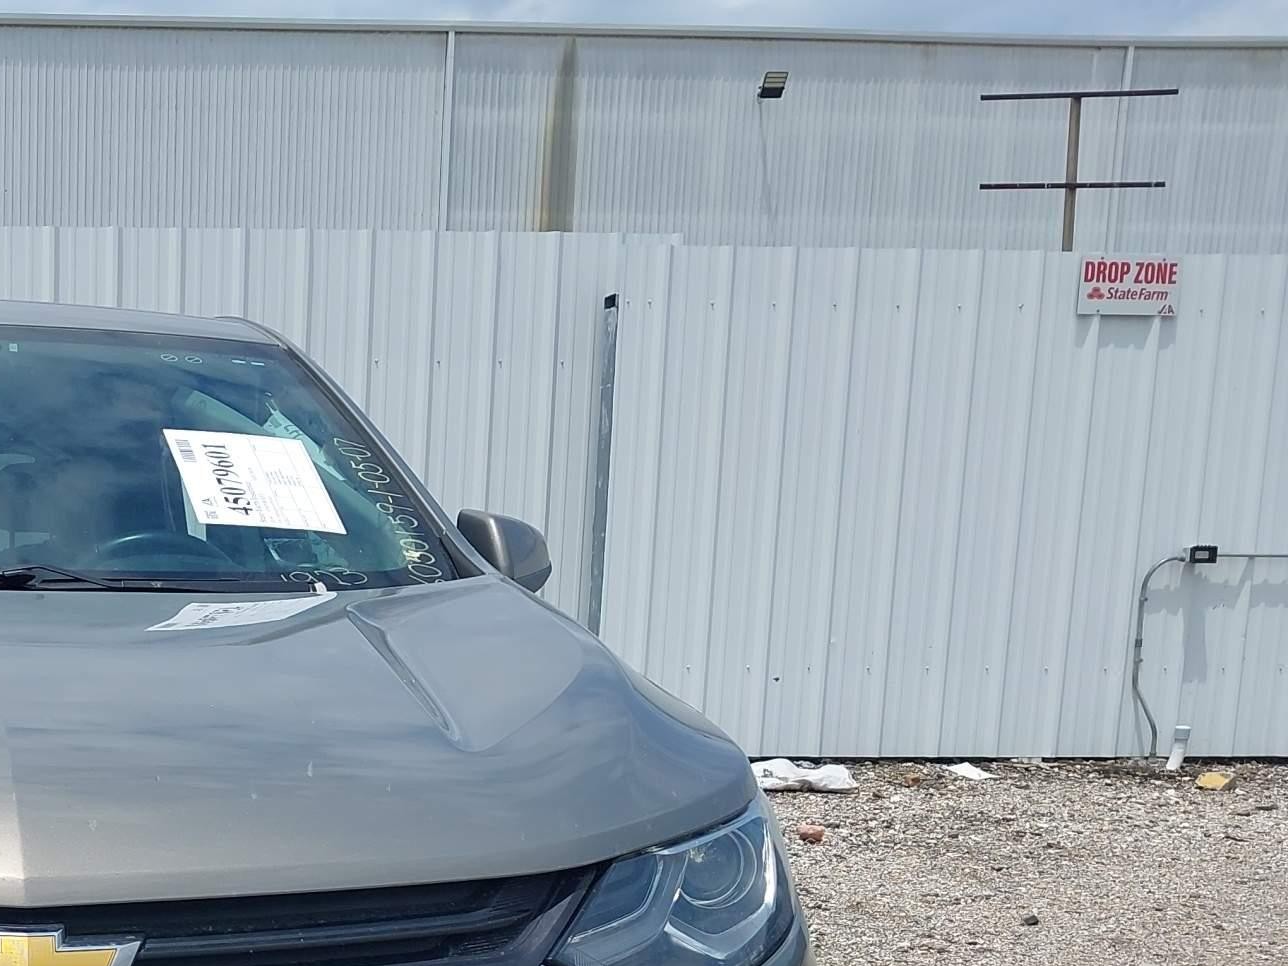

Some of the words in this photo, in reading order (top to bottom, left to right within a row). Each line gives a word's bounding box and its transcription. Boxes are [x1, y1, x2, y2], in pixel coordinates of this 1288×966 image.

[1084, 261, 1131, 284] DROP
[1134, 262, 1178, 285] ZONE
[201, 443, 253, 516] 45079601
